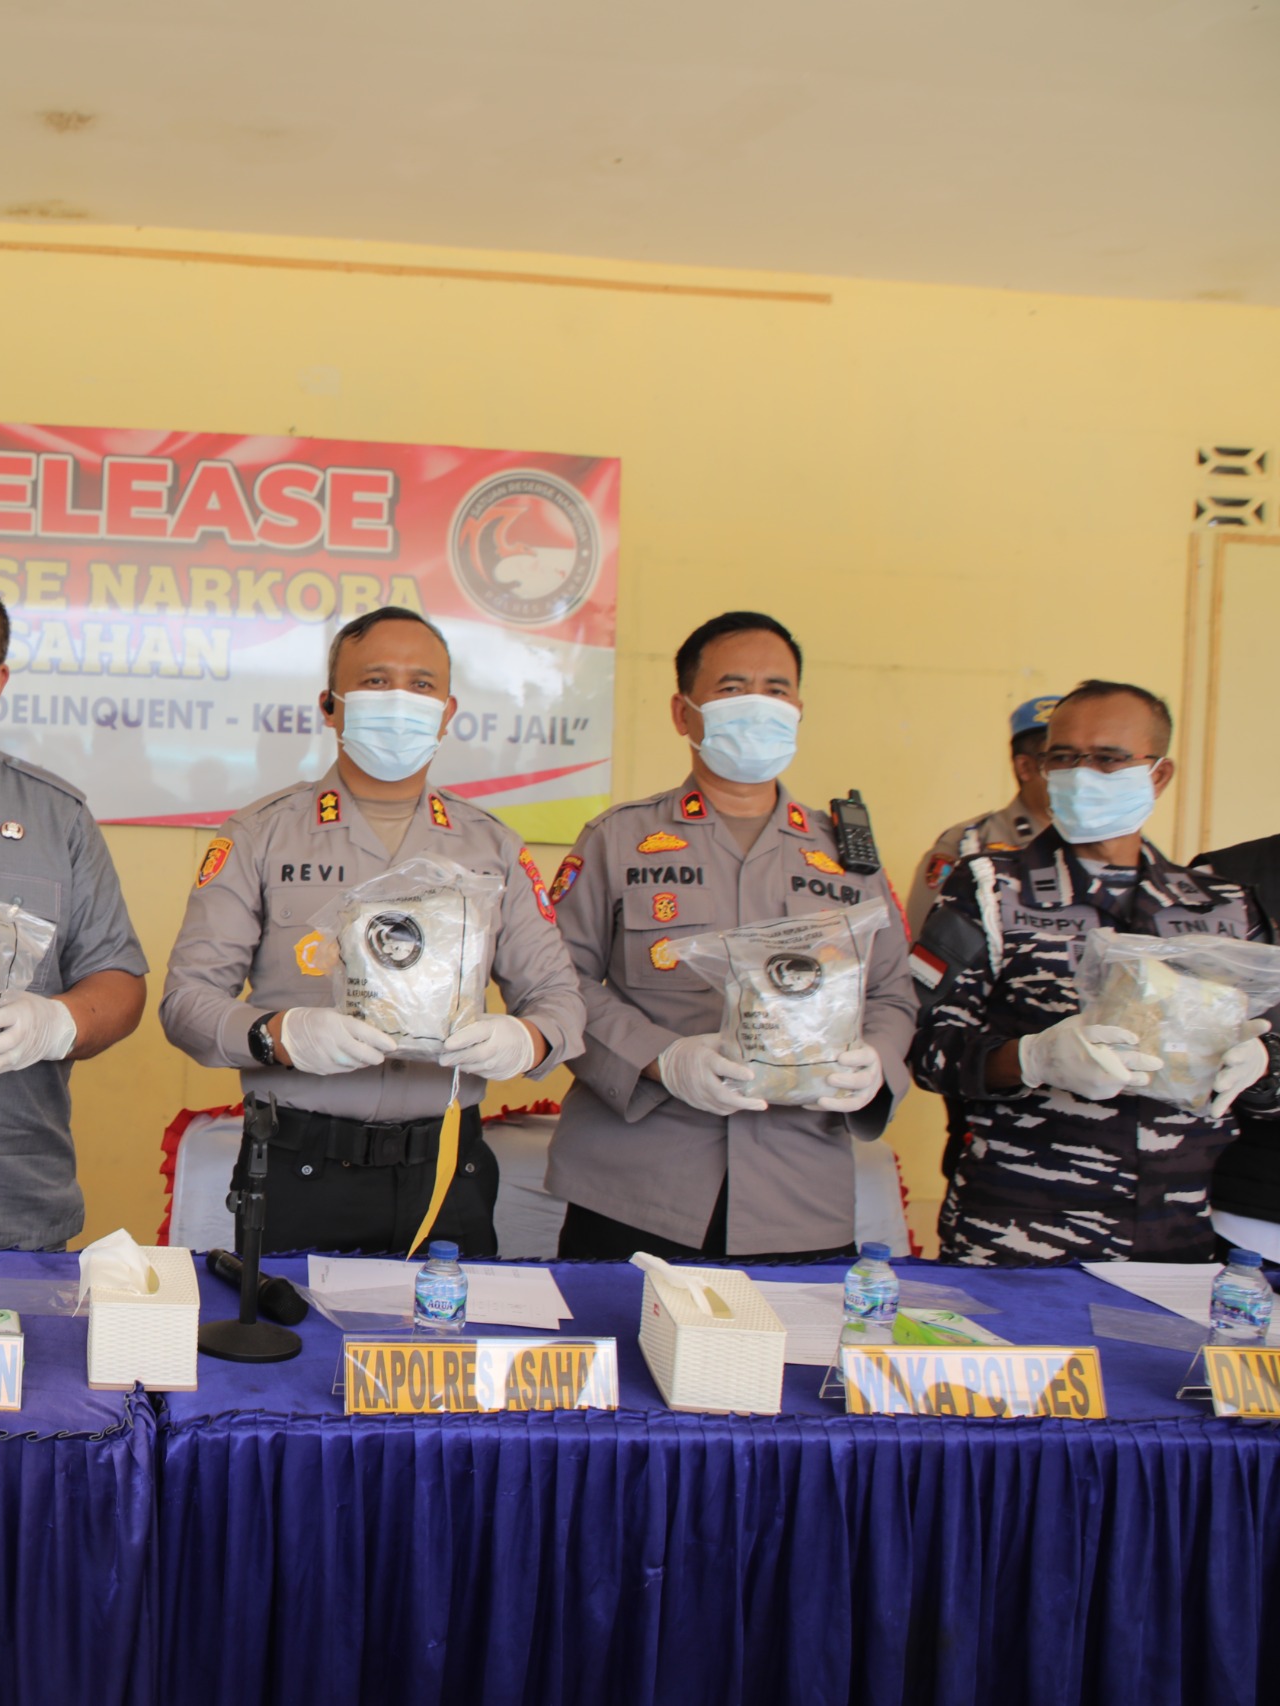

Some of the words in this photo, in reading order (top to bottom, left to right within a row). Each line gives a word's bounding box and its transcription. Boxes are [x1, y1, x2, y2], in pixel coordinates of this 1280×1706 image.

[89, 563, 428, 623] NARKOBA
[7, 617, 232, 681] SAHAN
[453, 710, 498, 742] OF
[281, 864, 345, 883] REVI
[626, 867, 704, 886] RIYADI
[791, 875, 861, 905] POLRI
[1014, 909, 1087, 932] HEPPY
[1168, 919, 1210, 935] TNI
[428, 1299, 454, 1311] AQUA
[352, 1349, 493, 1409] KAPOLRES
[504, 1350, 612, 1410] ASAHAN
[853, 1356, 958, 1415] WAKA
[961, 1357, 1090, 1417] POLRES
